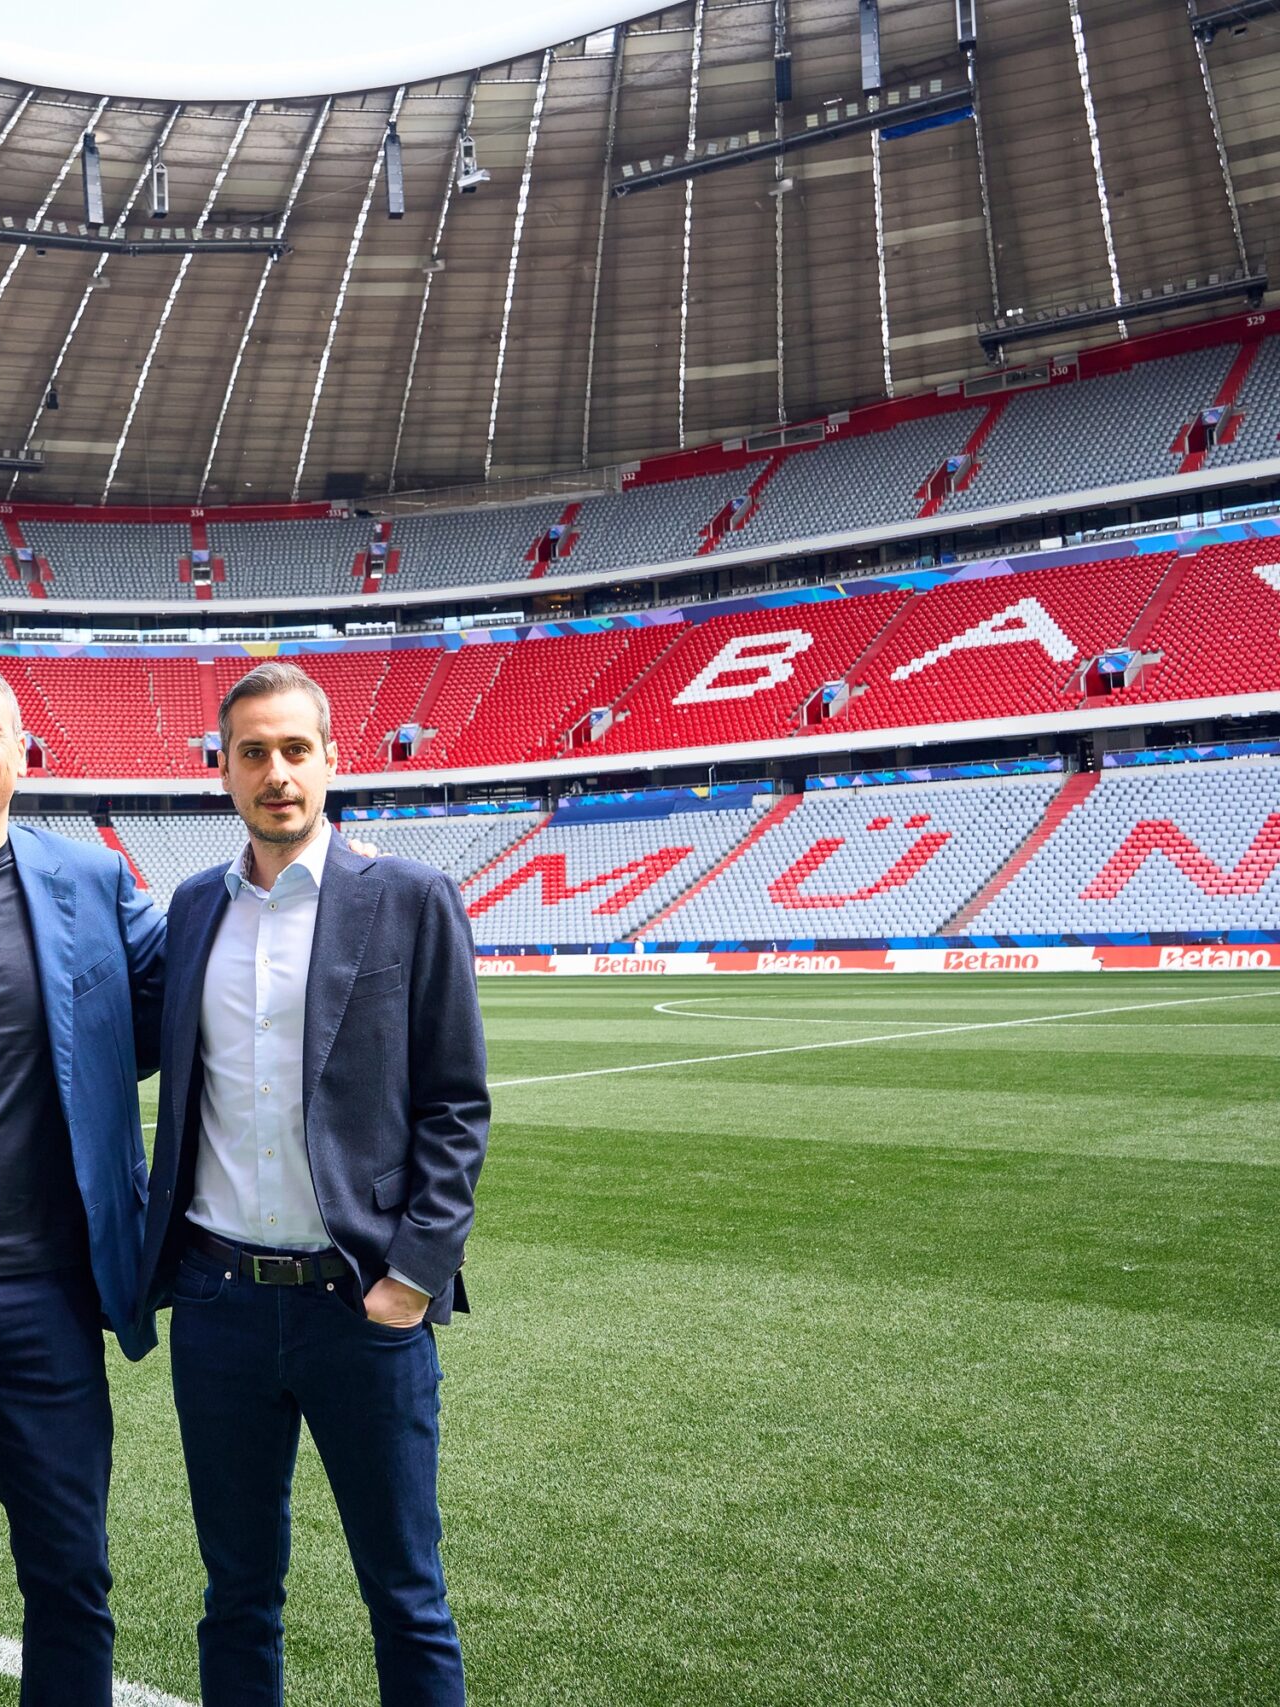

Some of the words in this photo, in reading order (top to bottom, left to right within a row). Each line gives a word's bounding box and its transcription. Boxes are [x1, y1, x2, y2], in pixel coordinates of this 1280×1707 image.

[1246, 315, 1266, 327] 329
[1051, 366, 1069, 377] 330
[825, 425, 839, 434] 331
[622, 473, 636, 482] 332
[190, 509, 204, 518] 334
[594, 956, 665, 972] Betano
[756, 952, 841, 972] Betano
[944, 950, 1039, 970] Betano
[1159, 946, 1271, 968] Betano
[475, 957, 515, 976] tano
